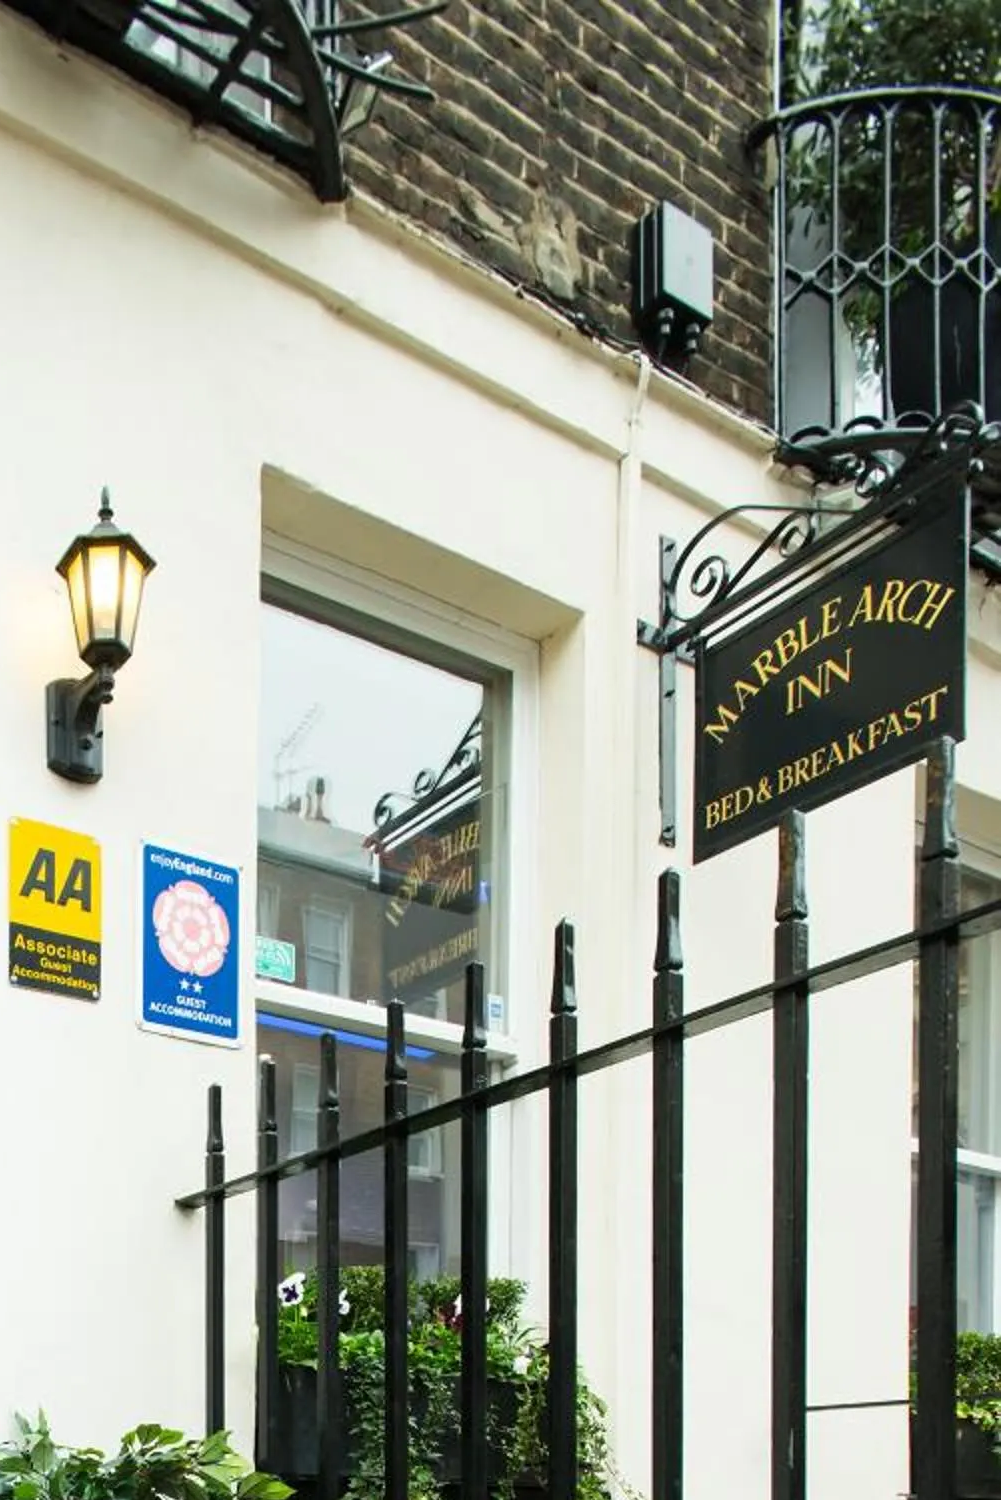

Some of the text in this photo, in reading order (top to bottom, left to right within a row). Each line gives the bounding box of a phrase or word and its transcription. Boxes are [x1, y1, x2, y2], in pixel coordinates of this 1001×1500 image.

[703, 579, 956, 744] MARBLE ARCH
[785, 649, 853, 716] INN
[777, 685, 949, 795] BREAKFAST
[19, 847, 92, 913] AA
[150, 853, 234, 885] enjoyEngland.com
[14, 933, 98, 966] Associate
[40, 957, 72, 973] Guest
[12, 964, 98, 992] Accommodation
[149, 1001, 232, 1028] ACCOMMODATION
[176, 995, 207, 1010] GUEST
